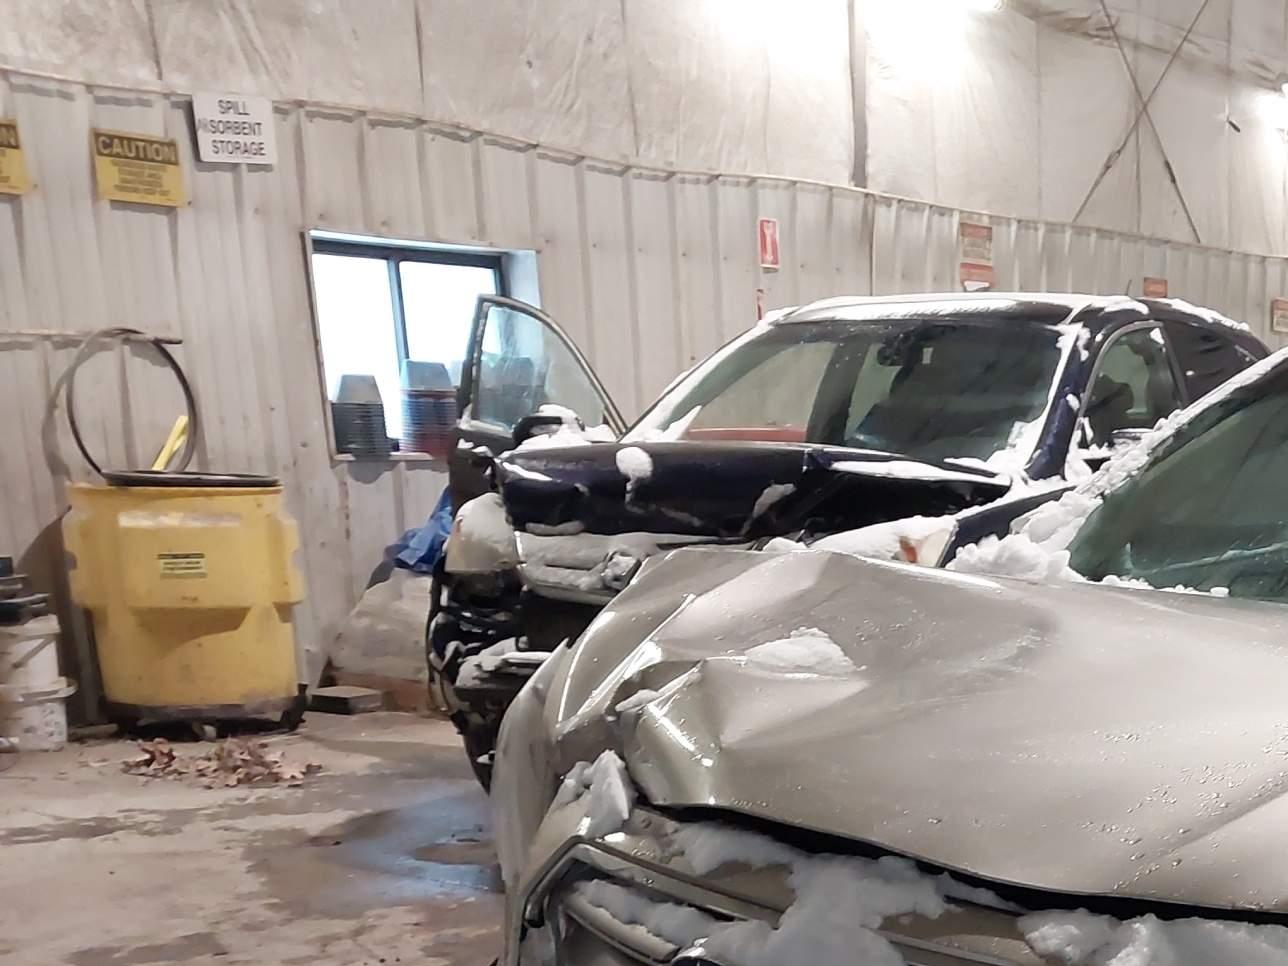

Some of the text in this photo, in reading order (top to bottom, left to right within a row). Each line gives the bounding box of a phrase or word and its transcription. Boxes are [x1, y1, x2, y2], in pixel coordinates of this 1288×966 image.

[218, 99, 250, 115] SPILL
[98, 136, 175, 162] CAUTION
[211, 139, 266, 156] STORAGE
